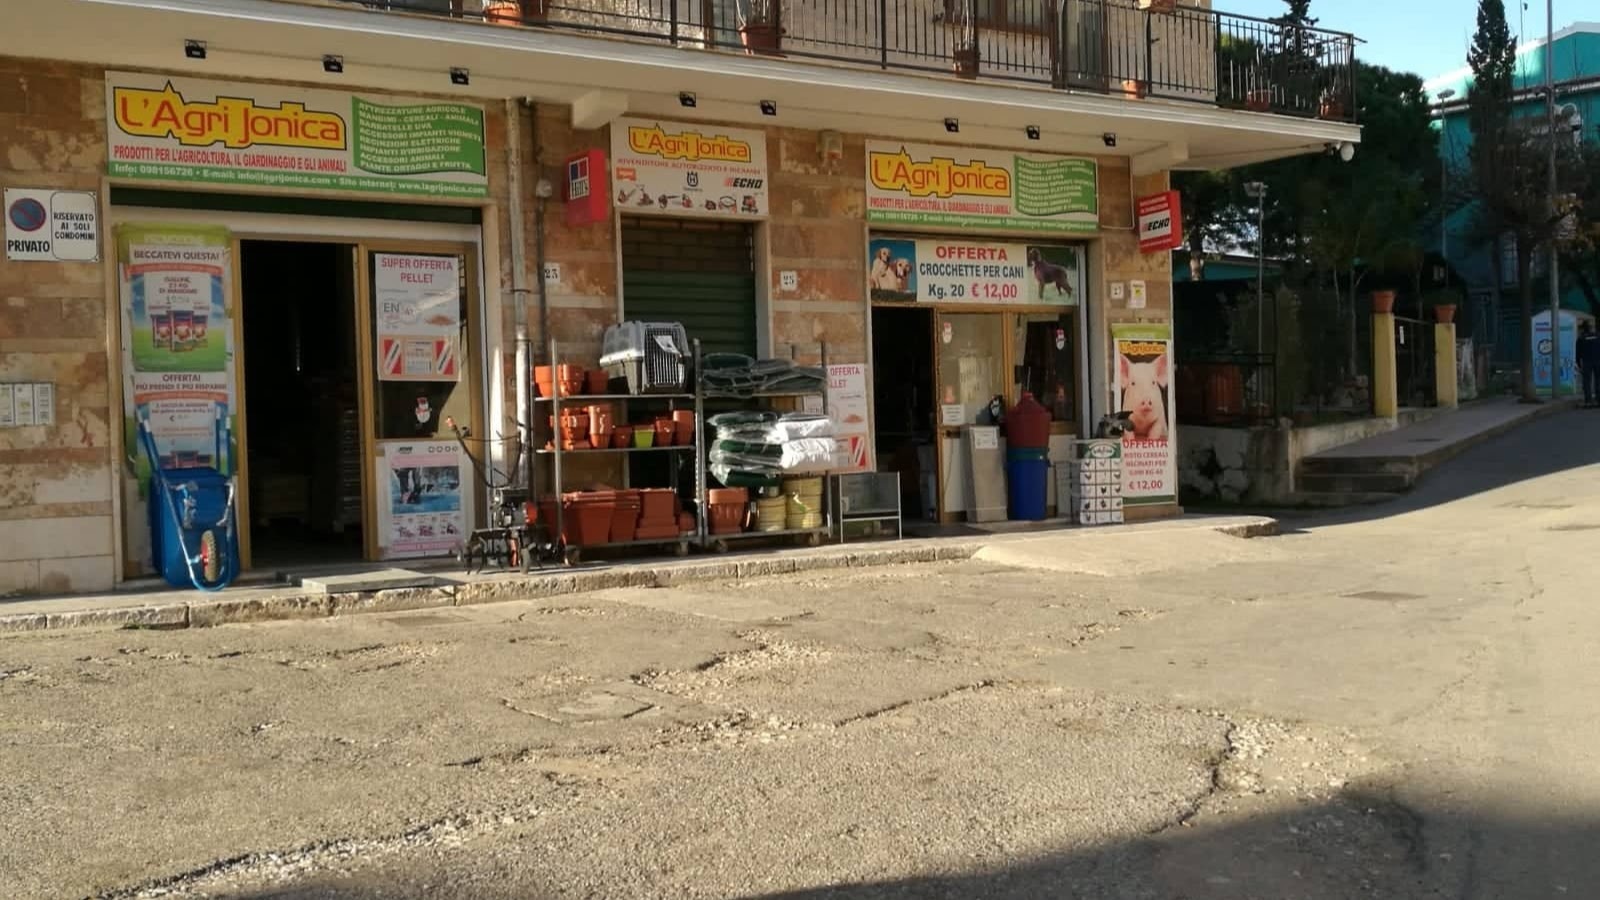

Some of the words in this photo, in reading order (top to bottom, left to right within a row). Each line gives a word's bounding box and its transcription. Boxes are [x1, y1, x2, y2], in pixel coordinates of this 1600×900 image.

[114, 145, 153, 159] PRODOTTI
[155, 147, 170, 161] PER
[244, 154, 296, 169] GIARDINAGGIO
[304, 159, 316, 171] GLI
[318, 159, 347, 173] ANIMALI
[733, 178, 763, 189] ECHO
[53, 212, 94, 221] RISERVATO
[60, 222, 71, 231] AI
[73, 223, 91, 231] SOLI
[1148, 217, 1170, 231] ECHO
[54, 231, 95, 241] CONDOMINI
[7, 239, 50, 253] PRIVATO
[134, 250, 181, 260] BECCATEVI
[935, 245, 1008, 261] OFFERTA
[381, 257, 411, 269] SUPER
[413, 260, 453, 271] OFFERTA
[919, 263, 981, 278] CROCCHETTE
[983, 265, 1001, 279] PER
[1002, 265, 1024, 279] CANI
[400, 272, 433, 285] PELLET
[928, 284, 947, 299] Kg.
[951, 284, 965, 297] 20
[971, 284, 979, 297] €
[983, 284, 1018, 300] 12,00
[830, 366, 860, 377] OFFERTA
[1122, 438, 1168, 449] OFFERTA
[1137, 479, 1163, 490] 12,00
